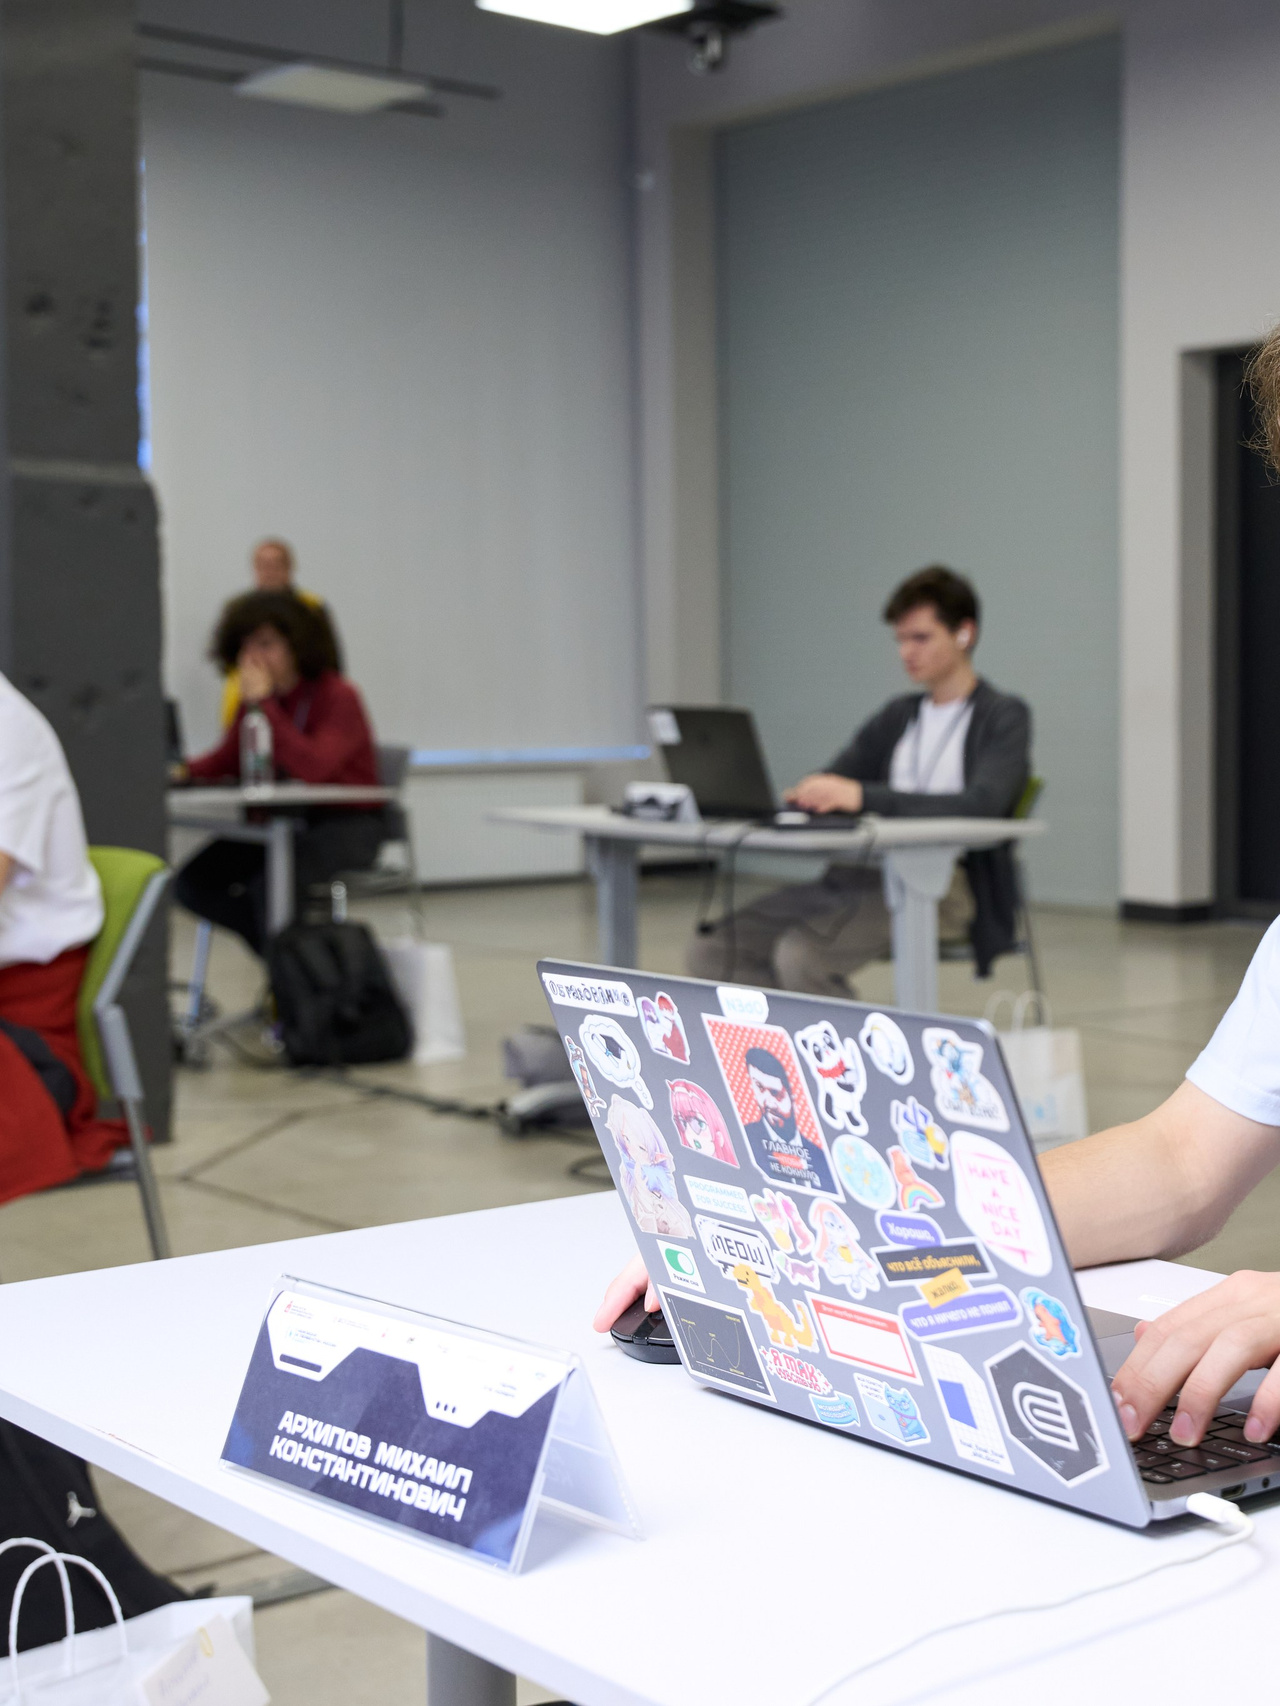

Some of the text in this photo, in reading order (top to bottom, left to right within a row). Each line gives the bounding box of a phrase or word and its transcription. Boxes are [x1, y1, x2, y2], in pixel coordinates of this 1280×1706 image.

[762, 1139, 811, 1160] ГЛАВНОЕ
[968, 1158, 1009, 1184] HAVE
[688, 1180, 745, 1200] PROGRAMMED
[992, 1186, 1002, 1199] A
[695, 1194, 747, 1214] FOR SUCCESS
[981, 1201, 1019, 1222] NICE
[991, 1221, 1021, 1240] DAY
[711, 1234, 765, 1267] MEOW
[770, 1349, 783, 1367] Я
[277, 1410, 474, 1494] АРХИПОВ МИХАИЛ
[269, 1435, 467, 1522] КОНСТАНТИНОВИЧ
